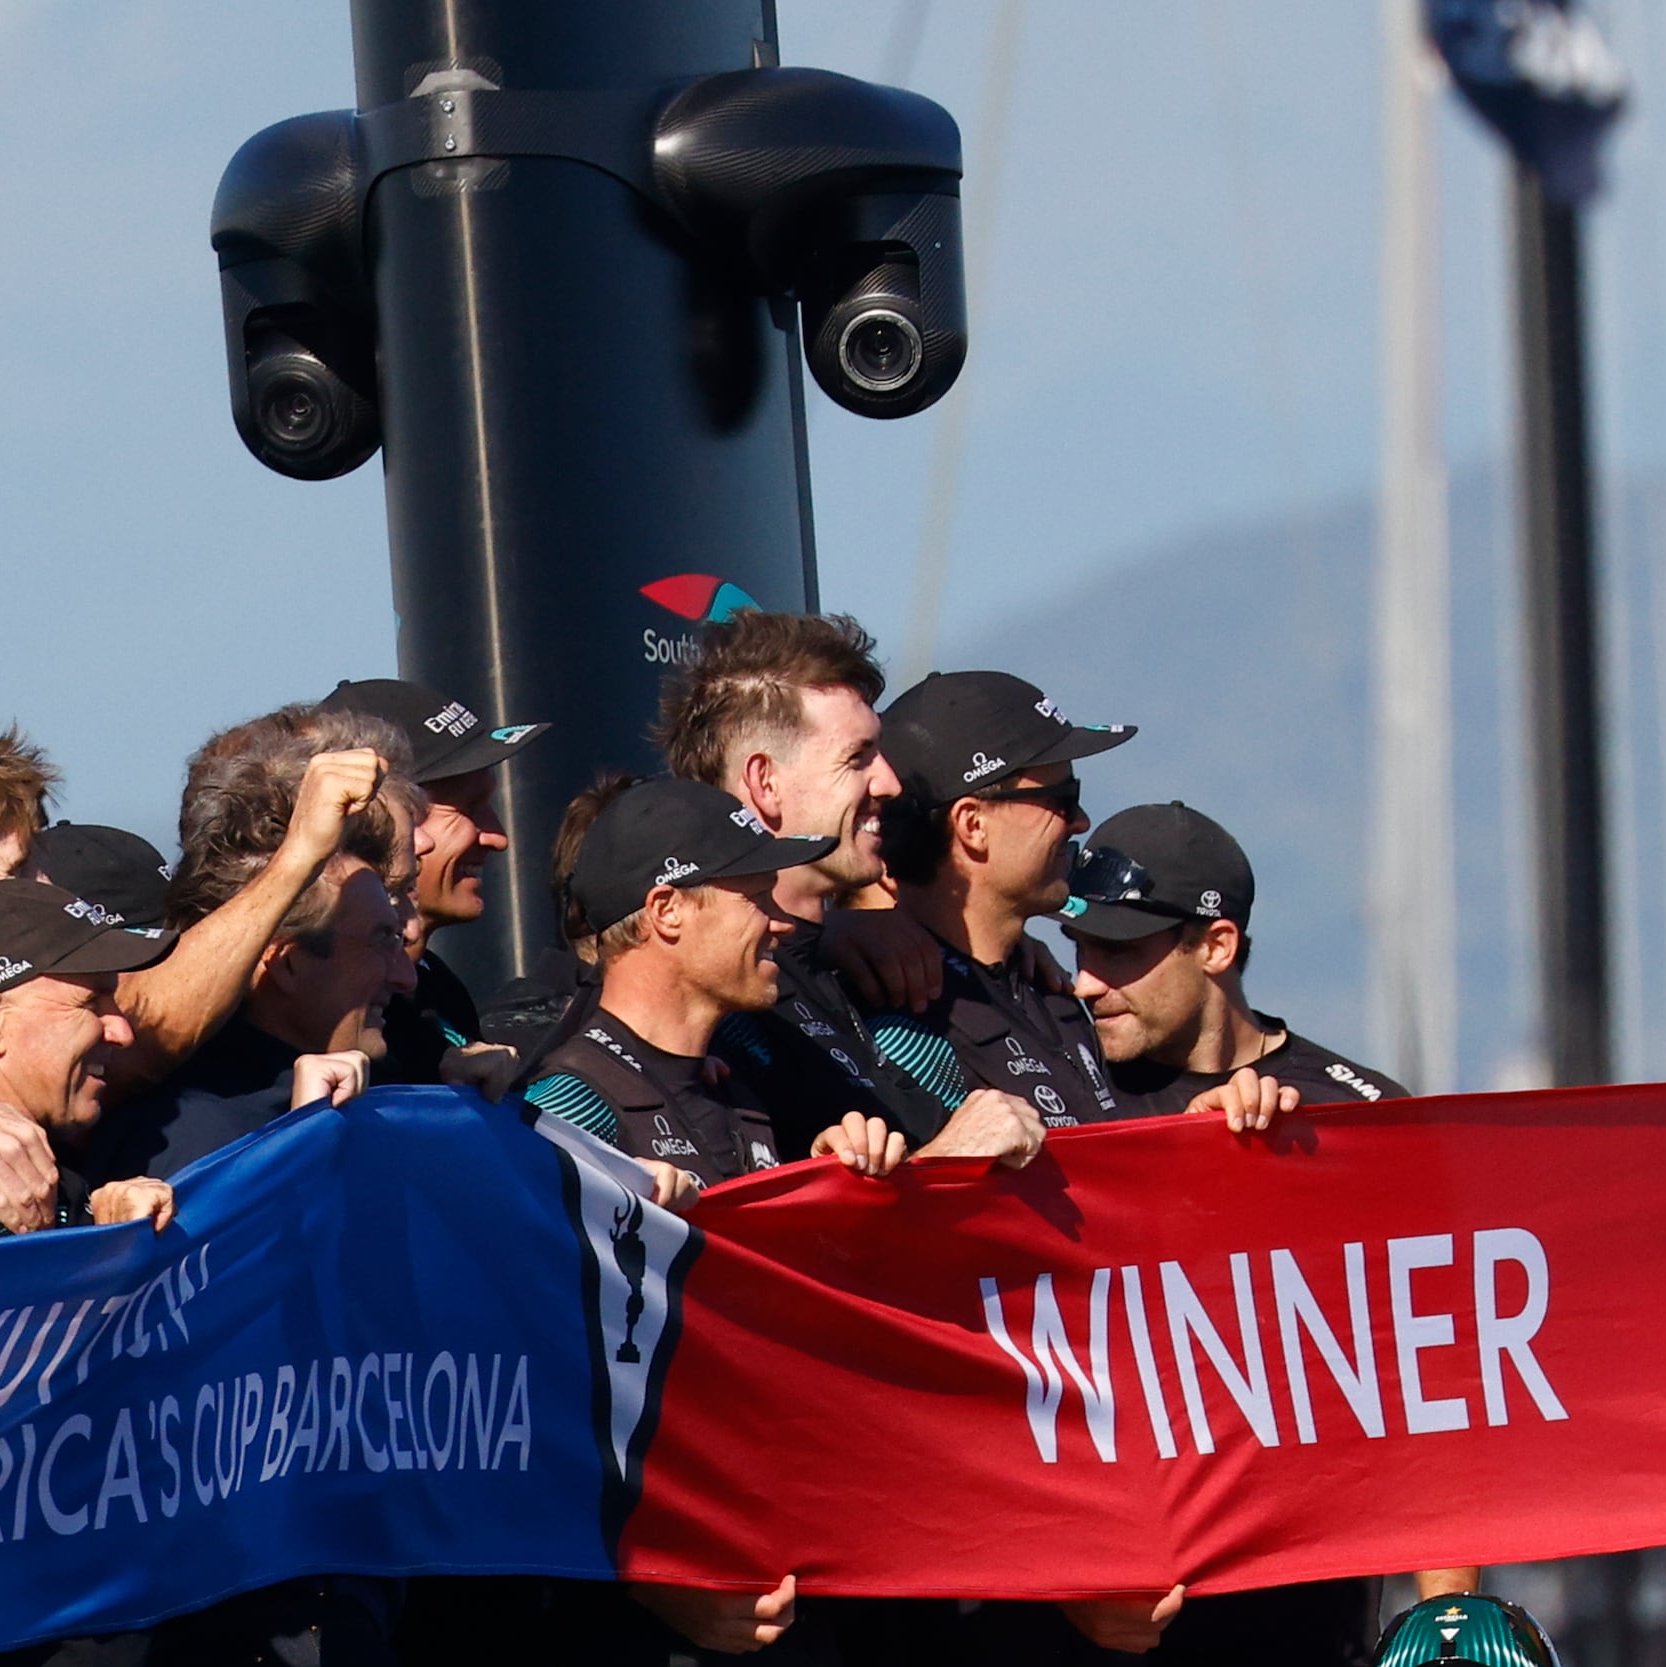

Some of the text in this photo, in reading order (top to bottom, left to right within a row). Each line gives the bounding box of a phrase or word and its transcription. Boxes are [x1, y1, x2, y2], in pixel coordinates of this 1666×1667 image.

[962, 757, 1006, 783] OMEGA
[655, 862, 700, 886] OMEGA
[1324, 1063, 1382, 1103] SLAM
[1044, 1115, 1079, 1128] TOYOTA
[651, 1138, 700, 1157] OMEGA
[978, 1227, 1570, 1464] WINNER
[191, 1371, 265, 1507] CUP
[259, 1350, 532, 1483] BARCELONA
